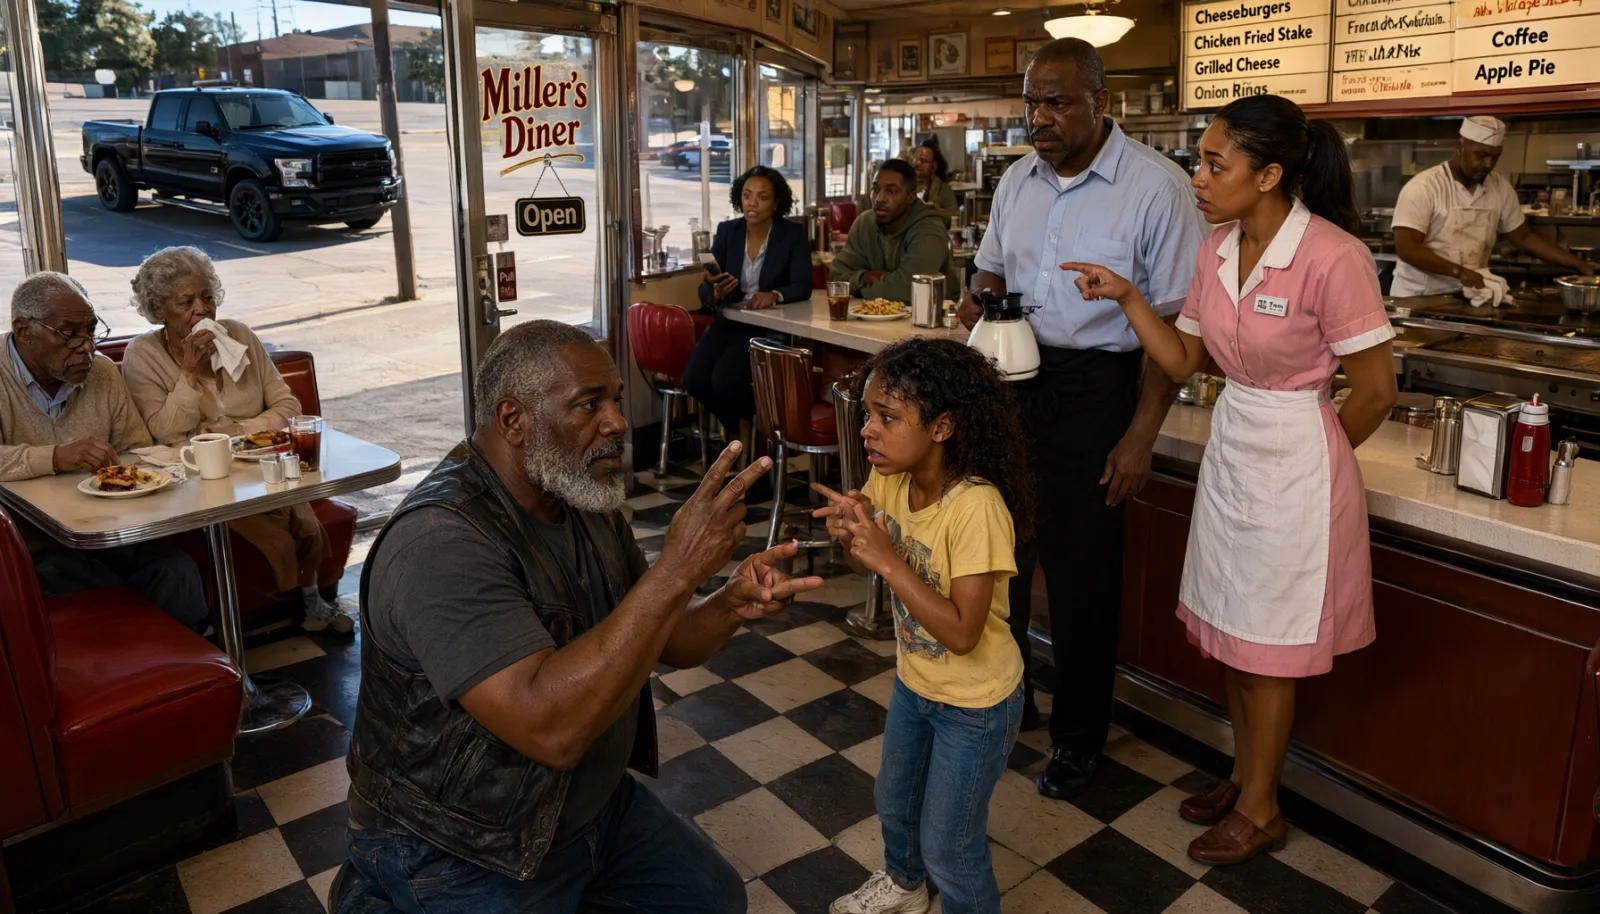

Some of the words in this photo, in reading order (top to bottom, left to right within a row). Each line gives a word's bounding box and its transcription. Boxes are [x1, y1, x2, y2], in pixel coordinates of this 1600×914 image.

[1195, 1, 1291, 24] Cheeseburgers
[1194, 33, 1241, 50] Chicken
[1244, 27, 1275, 45] Fried
[1278, 24, 1313, 41] Stake
[1492, 26, 1549, 48] Coffee
[1194, 58, 1233, 75] Grilled
[1236, 57, 1280, 72] Cheese
[1474, 60, 1522, 85] Apple
[1528, 58, 1556, 76] Pie
[480, 64, 589, 123] Miller's
[1194, 85, 1229, 100] Onion
[501, 116, 581, 160] Diner
[523, 203, 577, 233] Open
[499, 271, 515, 283] Pull
